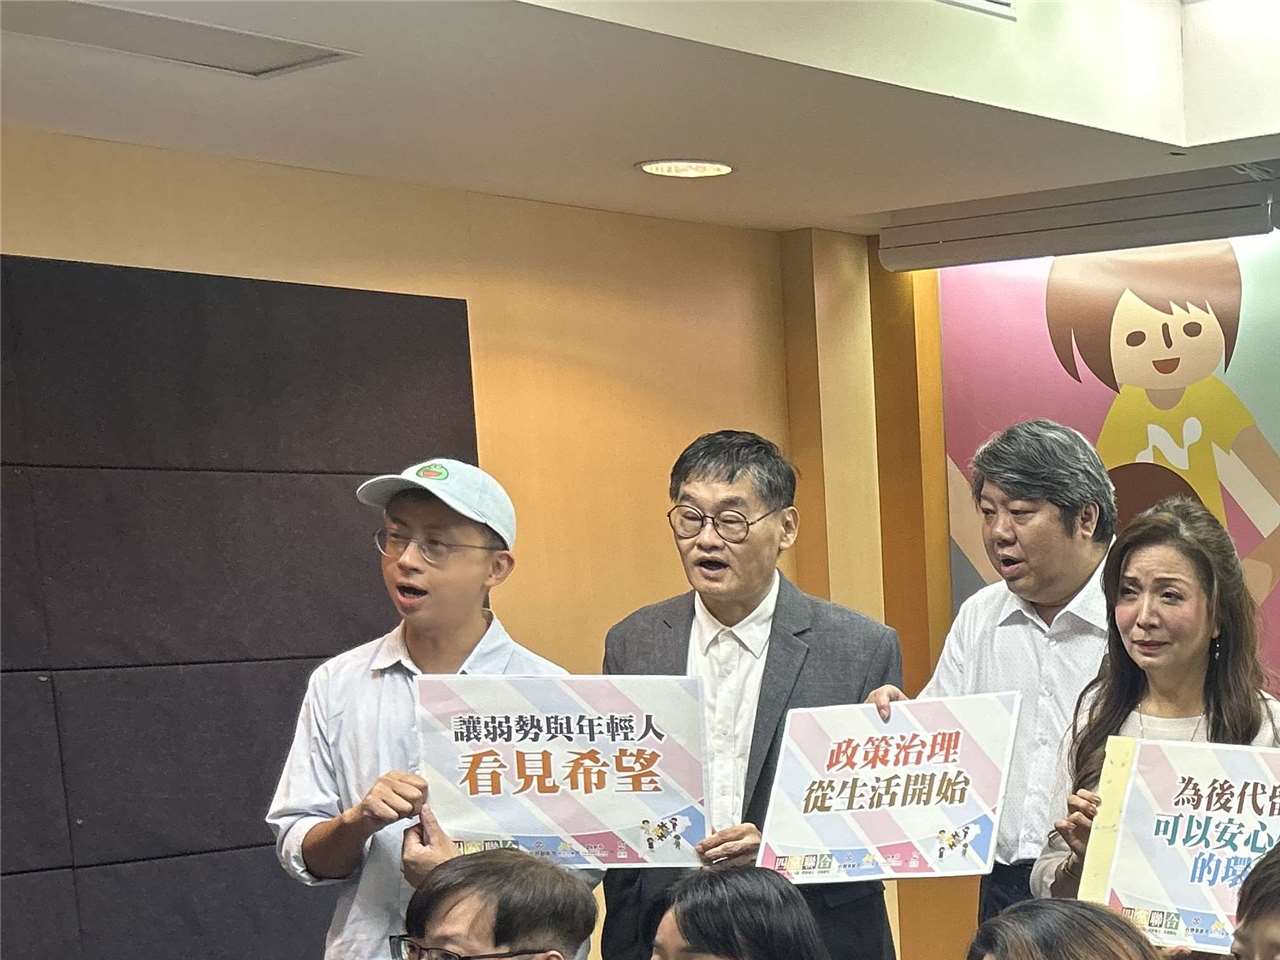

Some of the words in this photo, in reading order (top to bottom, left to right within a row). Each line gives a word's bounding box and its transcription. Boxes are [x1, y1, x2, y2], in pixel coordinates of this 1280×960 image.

[454, 715, 665, 743] 讓弱勢與年輕人
[827, 730, 960, 771] 政策治理
[460, 749, 663, 796] 看見希望
[803, 771, 971, 814] 從生活開始
